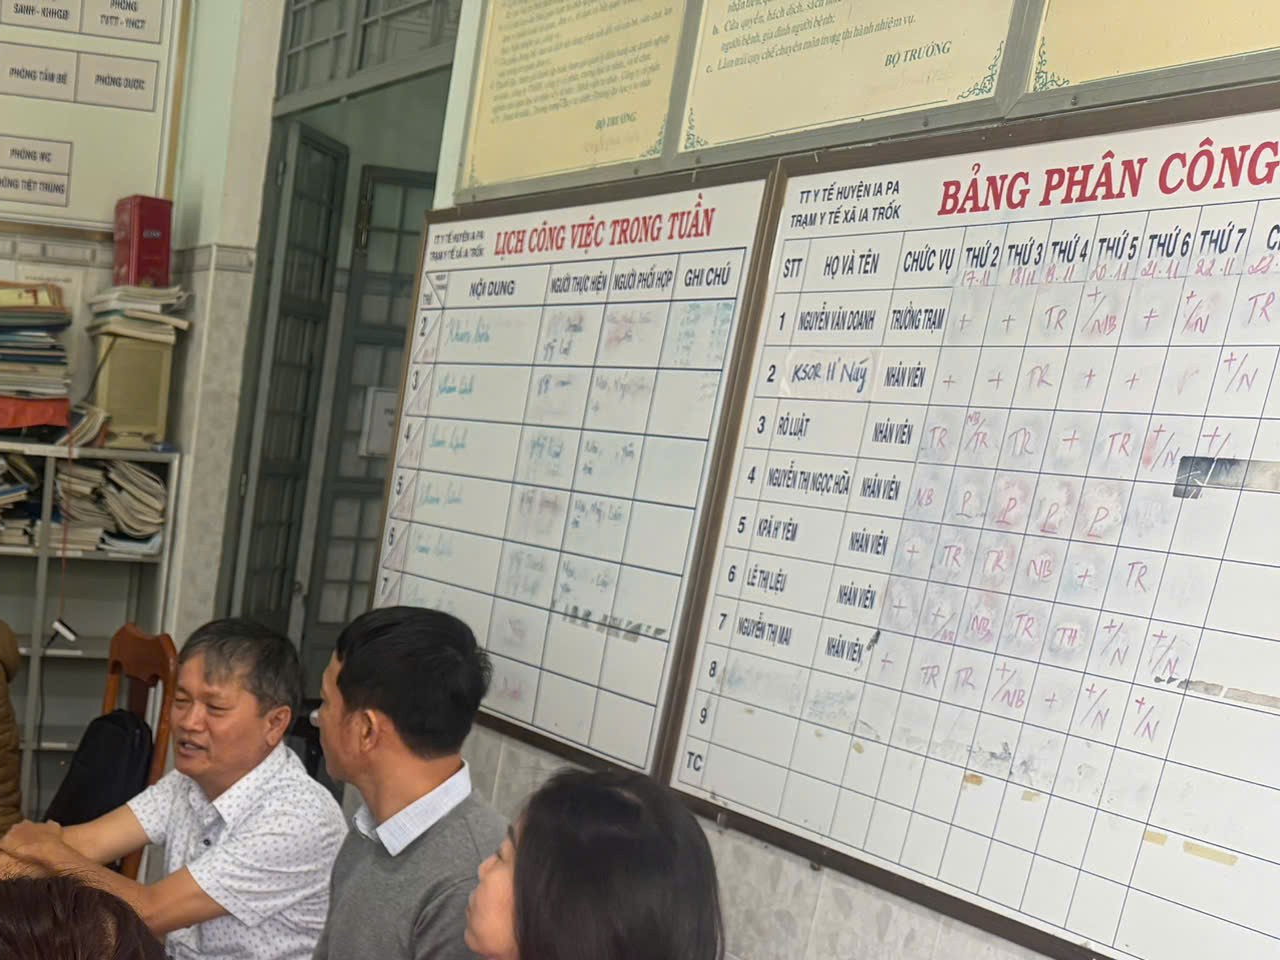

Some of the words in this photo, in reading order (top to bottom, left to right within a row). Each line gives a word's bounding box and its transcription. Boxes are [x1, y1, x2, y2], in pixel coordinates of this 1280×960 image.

[884, 52, 901, 68] BỘ
[903, 40, 952, 63] TRƯỞNG
[937, 162, 1030, 216] BẢNG
[1039, 149, 1148, 207] PHÂN
[1158, 137, 1280, 196] CÔNG
[800, 190, 810, 204] TT
[812, 189, 820, 202] Y
[822, 181, 835, 201] TẾ
[836, 180, 871, 203] HUYỆN
[872, 182, 883, 196] IA
[885, 181, 900, 196] PA
[494, 230, 528, 261] LỊCH
[528, 220, 566, 253] CÔNG
[571, 214, 606, 254] VIỆC
[609, 214, 663, 246] TRONG
[668, 193, 716, 240] TUẦN
[790, 214, 817, 230] TRẠM
[819, 212, 828, 225] Y
[828, 205, 841, 225] TẾ
[842, 205, 856, 224] XÃ
[858, 208, 869, 222] IA
[872, 199, 901, 221] TRỐK
[1008, 236, 1034, 266] THỨ
[1034, 243, 1043, 265] 3
[1051, 233, 1079, 263] THỨ
[1079, 239, 1089, 262] 4
[1098, 229, 1128, 260] THỨ
[1128, 236, 1139, 260] 5
[1147, 225, 1178, 259] THỨ
[1181, 231, 1190, 257] 6
[1200, 221, 1233, 255] THỨ
[1233, 228, 1247, 254] 7
[783, 258, 803, 278] STT
[823, 256, 840, 279] HỌ
[841, 250, 857, 275] VÀ
[858, 248, 880, 274] TÊN
[903, 244, 936, 272] CHỨC
[939, 248, 956, 275] VỤ
[966, 240, 990, 268] THỨ
[991, 246, 1000, 267] 2
[684, 268, 703, 287] GHI
[705, 261, 732, 286] CHÚ
[469, 278, 487, 300] NỘI
[487, 280, 516, 296] DUNG
[779, 312, 786, 331] 1
[798, 301, 831, 331] NGUYỄN
[846, 310, 876, 331] DOANH
[890, 301, 922, 331] TRƯỞNG
[922, 308, 946, 334] TRẠM
[766, 364, 777, 383] 2
[883, 361, 906, 387] NHÂN
[906, 361, 926, 388] VIÊN
[757, 415, 766, 434] 3
[871, 417, 894, 444] NHÂN
[894, 418, 913, 445] VIÊN
[747, 466, 756, 484] 4
[767, 460, 797, 489] NGUYỄN
[809, 472, 833, 496] NGỌC
[860, 473, 881, 499] NHÂN
[882, 475, 901, 501] VIÊN
[737, 516, 746, 534] 5
[848, 527, 869, 552] NHÂN
[869, 529, 889, 556] VIÊN
[727, 565, 736, 582] 6
[837, 581, 857, 606] NHÂN
[857, 584, 876, 610] VIÊN
[719, 613, 727, 630] 7
[737, 612, 766, 639] NGUYỄN
[777, 626, 793, 647] MAI
[825, 633, 846, 659] NHÂN
[846, 637, 864, 663] VIÊN
[709, 661, 717, 678] 8
[699, 706, 707, 725] 9
[686, 751, 704, 772] TC
